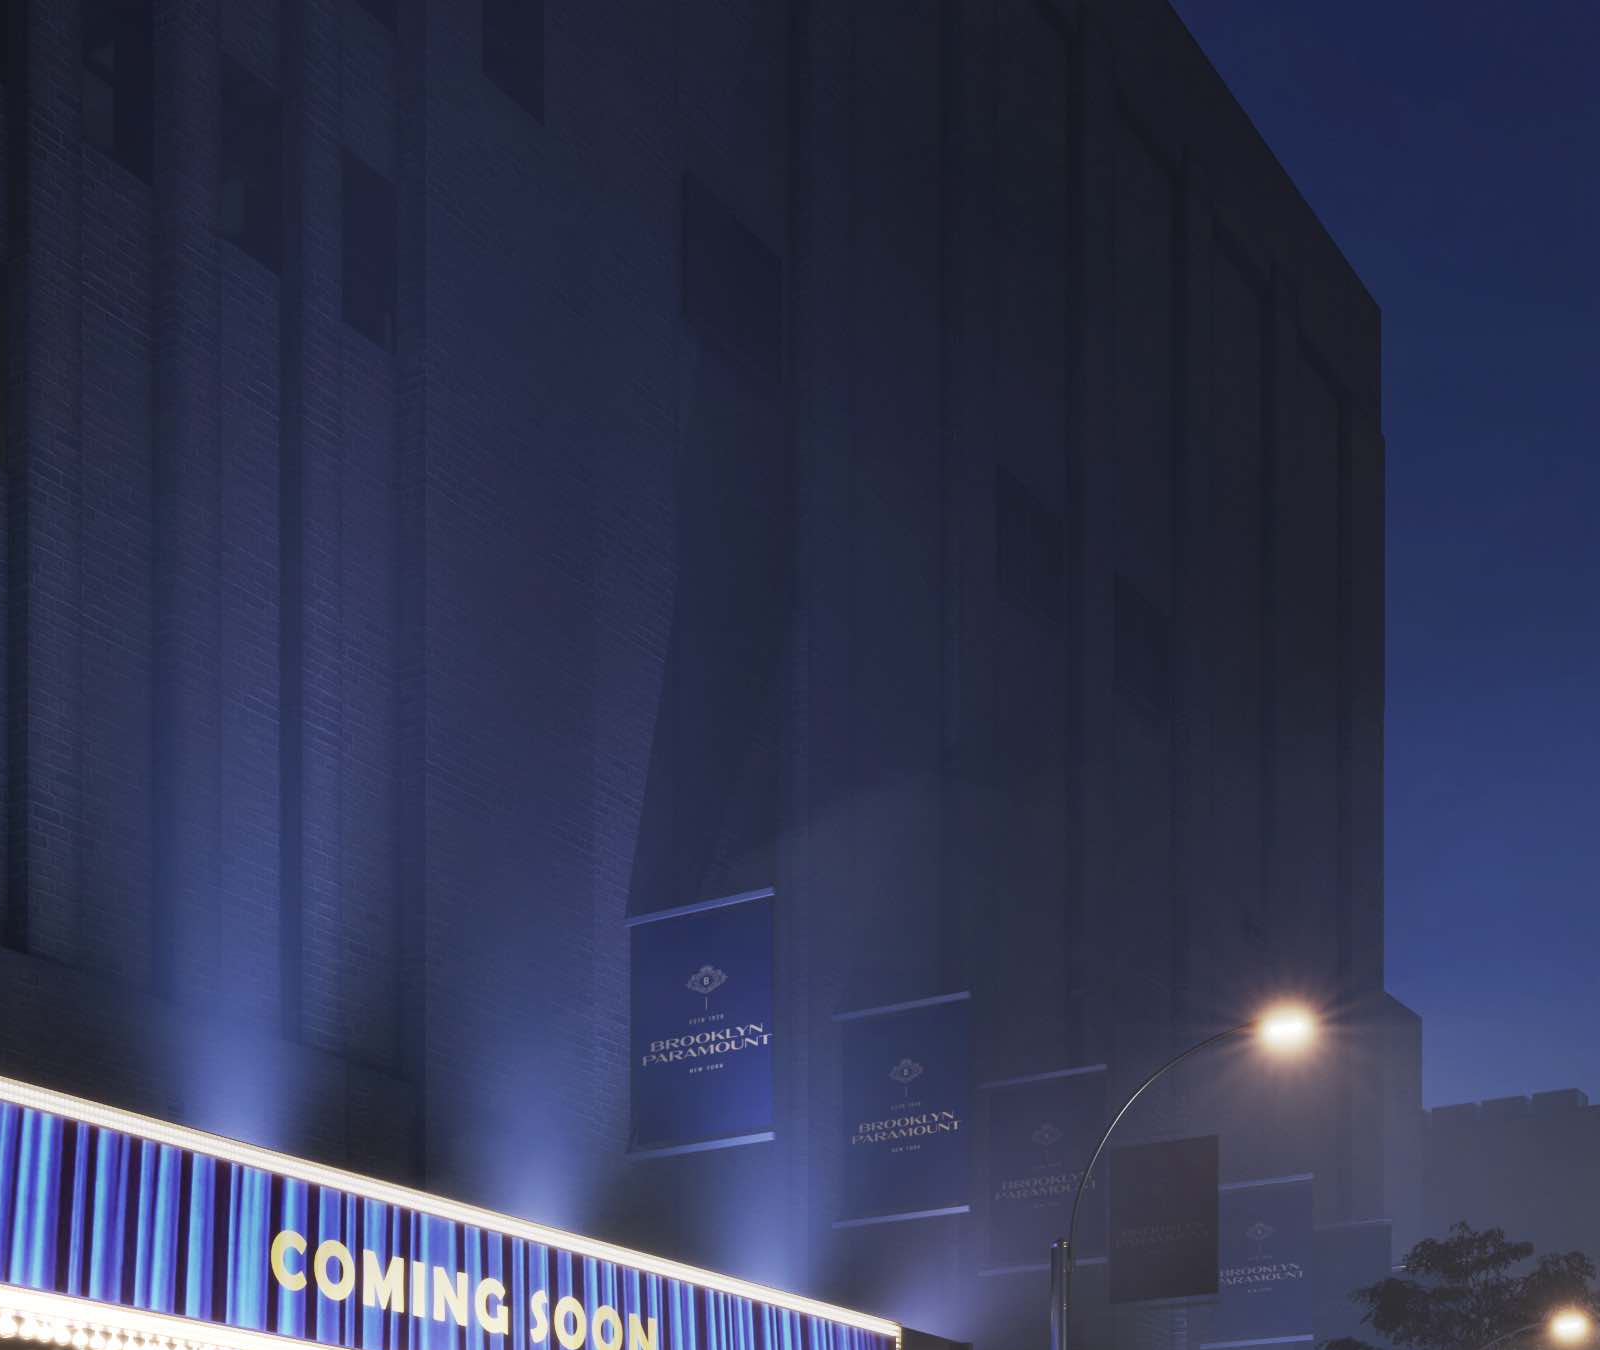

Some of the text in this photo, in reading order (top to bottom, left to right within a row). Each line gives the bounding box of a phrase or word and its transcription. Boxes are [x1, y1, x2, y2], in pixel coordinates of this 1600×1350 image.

[641, 1033, 773, 1067] PARAMOUNT
[650, 1022, 764, 1053] BROOKLYN
[852, 1119, 962, 1145] PARAMOUNT
[858, 1109, 954, 1133] BROOKLYN
[270, 1229, 509, 1336] COMING
